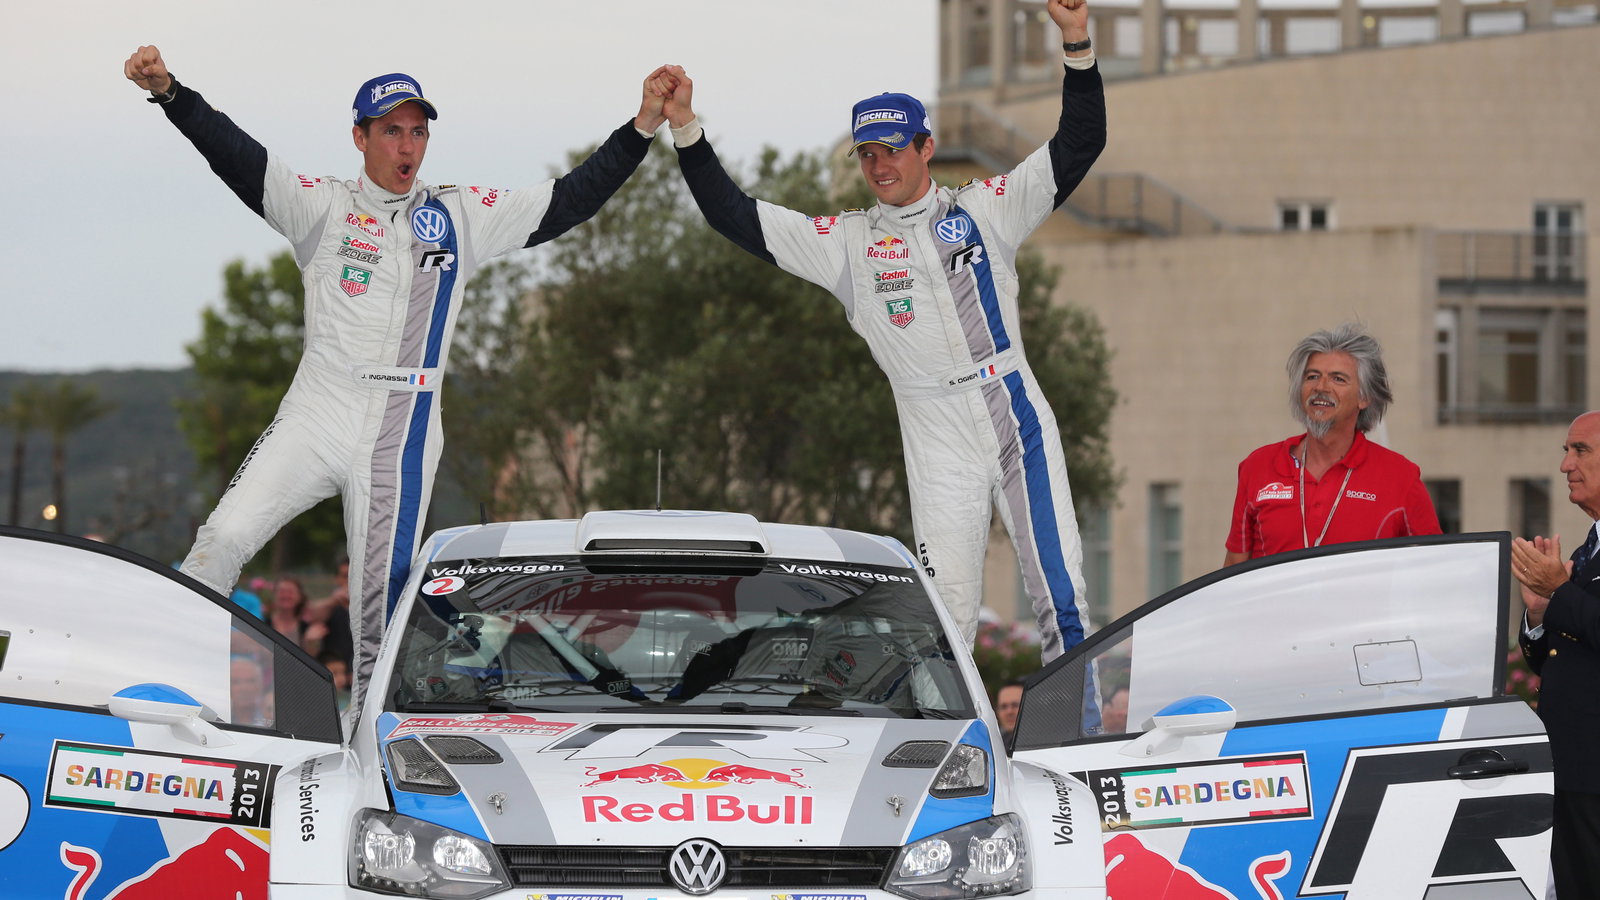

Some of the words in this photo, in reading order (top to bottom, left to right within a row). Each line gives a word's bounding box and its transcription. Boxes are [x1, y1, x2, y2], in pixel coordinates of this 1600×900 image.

[860, 111, 904, 123] MICHELIN
[384, 195, 410, 204] Volkswagen
[900, 208, 927, 220] Volkswagen
[350, 238, 380, 253] Castrol
[337, 245, 383, 264] EDGE
[867, 247, 887, 260] Red
[889, 247, 909, 260] Bull
[347, 268, 366, 283] TAG
[881, 268, 909, 281] Castrol
[341, 279, 367, 295] HEUER
[874, 279, 914, 293] EDGE
[889, 301, 908, 313] TAG
[889, 311, 913, 327] HEUER
[957, 372, 978, 384] OGIER
[1346, 490, 1377, 501] sparco
[431, 563, 565, 576] Volkswagen
[779, 563, 914, 584] Volkswagen
[434, 577, 455, 594] 2
[772, 642, 808, 656] OMP
[504, 686, 540, 701] OMP
[608, 680, 630, 693] OMP
[499, 722, 568, 730] Sardegna
[66, 764, 224, 802] SARDEGNA
[238, 768, 260, 819] 2013
[1103, 776, 1121, 826] 2013
[1134, 776, 1296, 810] SARDEGNA
[299, 784, 320, 842] Services
[582, 794, 694, 823] Red
[706, 795, 813, 825] Bull
